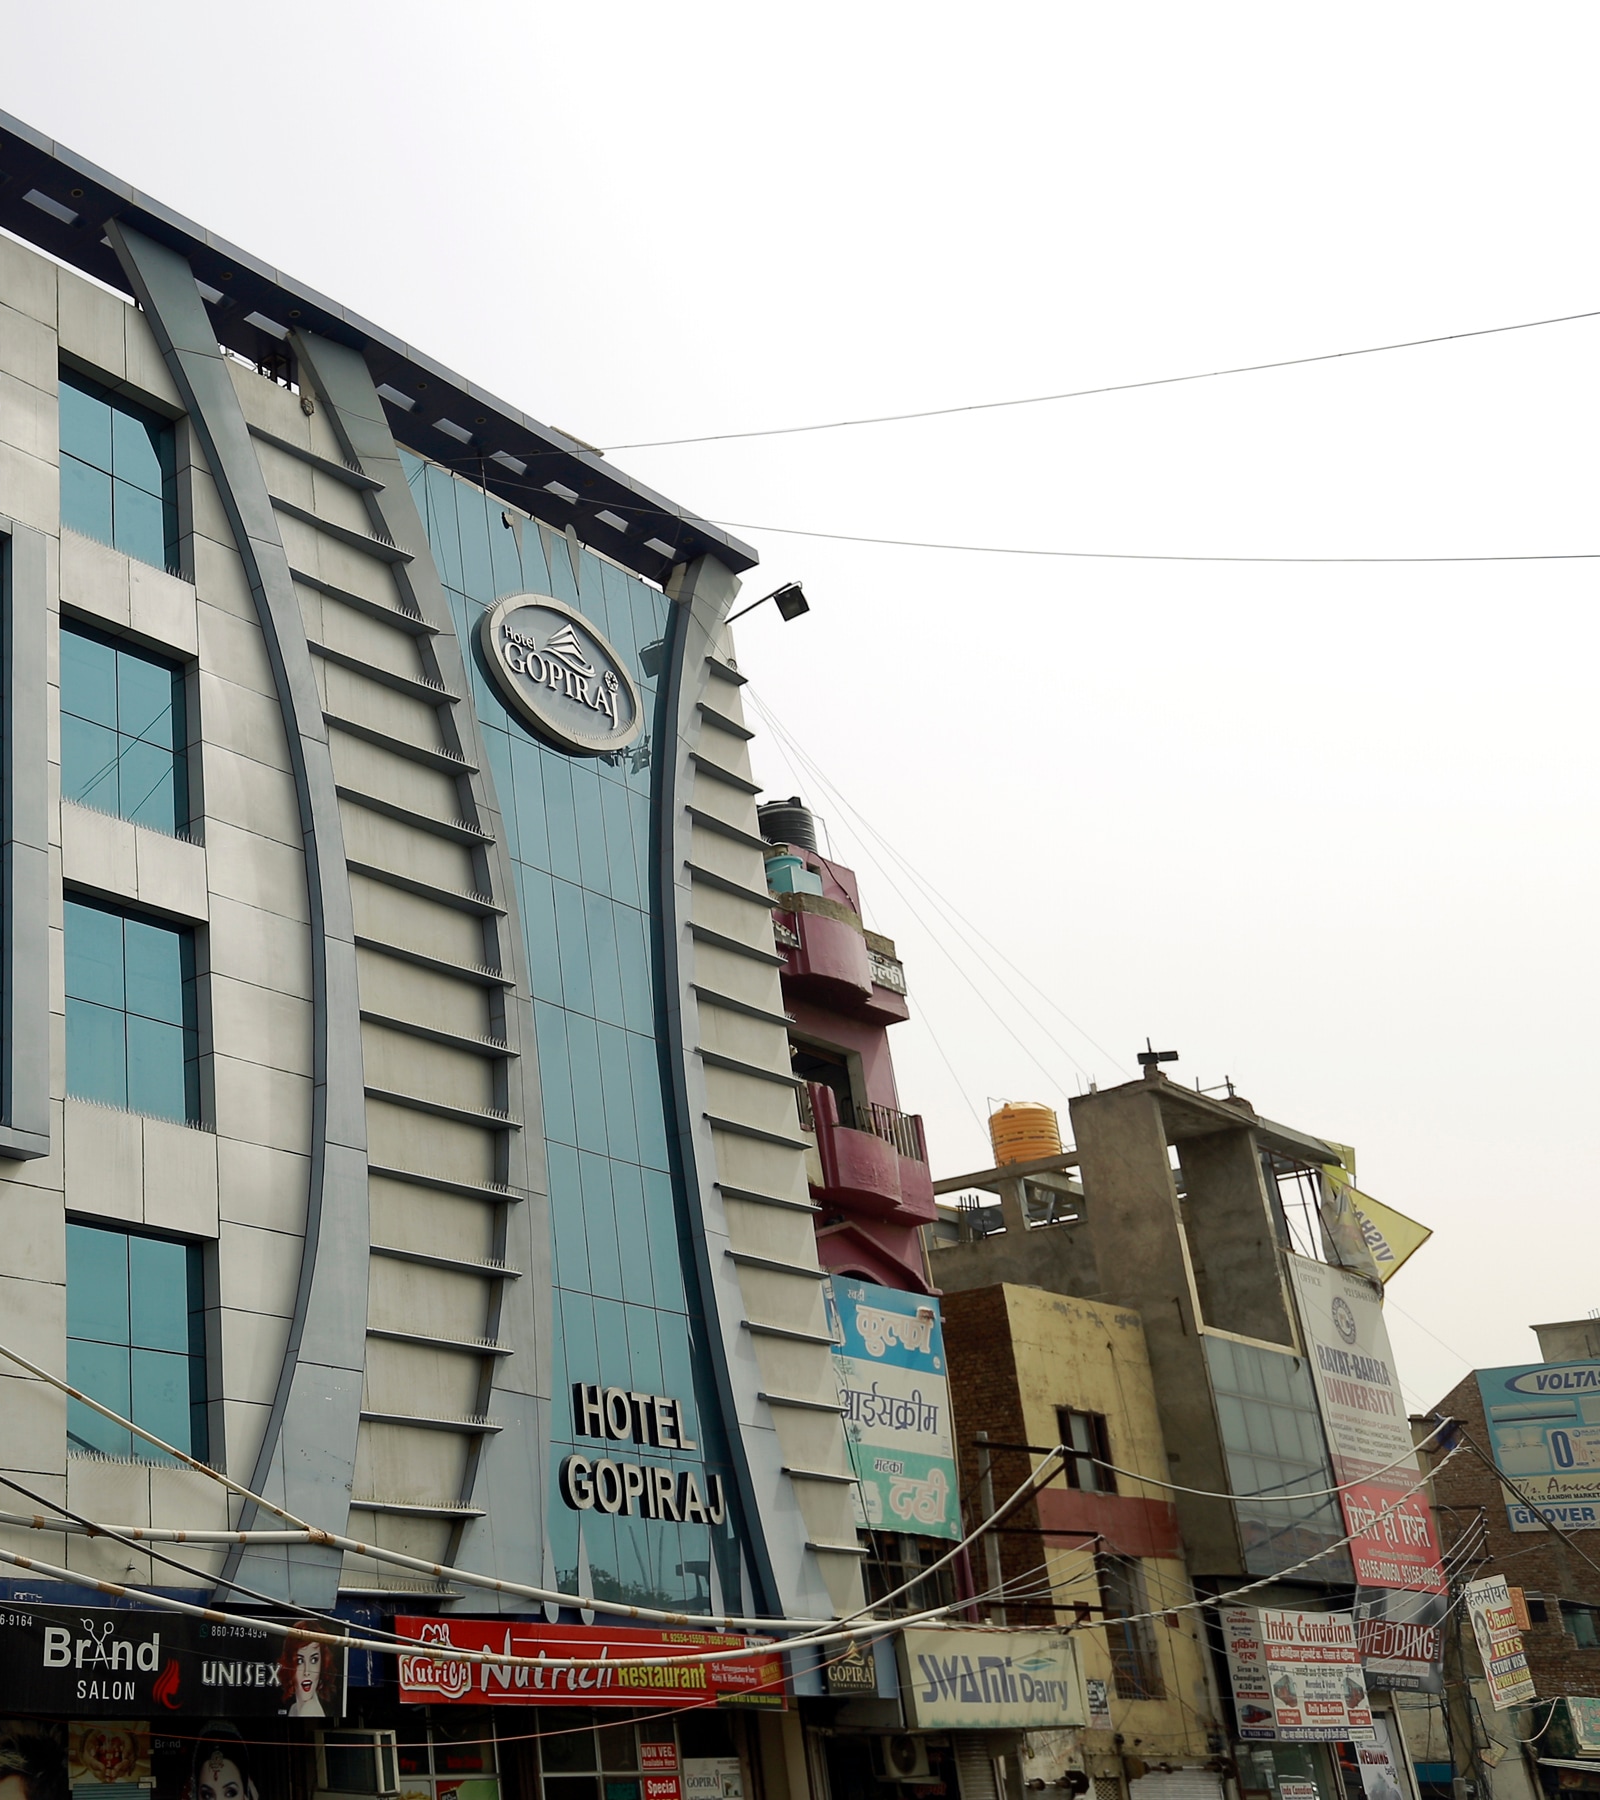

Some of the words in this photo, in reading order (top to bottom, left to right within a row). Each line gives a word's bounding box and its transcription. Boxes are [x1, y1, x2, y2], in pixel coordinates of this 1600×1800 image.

[503, 624, 536, 650] Hotel
[503, 642, 618, 730] GOPIRAJ
[1316, 1344, 1392, 1387] RAYAT-BAHRA
[1536, 1370, 1600, 1391] VOLTA
[1323, 1376, 1397, 1417] UNIVERSITY
[572, 1382, 697, 1451] HOTEL
[874, 1457, 904, 1475] मटका
[559, 1454, 725, 1526] GOPIRAJ
[889, 1467, 950, 1525] दही
[1514, 1507, 1596, 1524] GROVER
[1265, 1612, 1294, 1641] Indo
[1297, 1614, 1352, 1644] Canadian
[1494, 1608, 1517, 1629] Band
[1358, 1621, 1434, 1660] WEDDING
[1493, 1637, 1524, 1658] IELTS
[201, 1660, 282, 1688] UNISEX
[617, 1662, 708, 1689] Restaurant
[828, 1665, 876, 1689] GOPIRAJ
[1491, 1656, 1513, 1676] STUDY
[1511, 1653, 1528, 1669] VISA
[76, 1680, 136, 1700] SALON
[1021, 1672, 1068, 1712] Dairy
[1320, 1704, 1328, 1713] Bus
[641, 1746, 657, 1758] NON
[657, 1746, 675, 1758] VEG.
[646, 1779, 677, 1797] Special
[686, 1776, 720, 1790] GOPIRAJ
